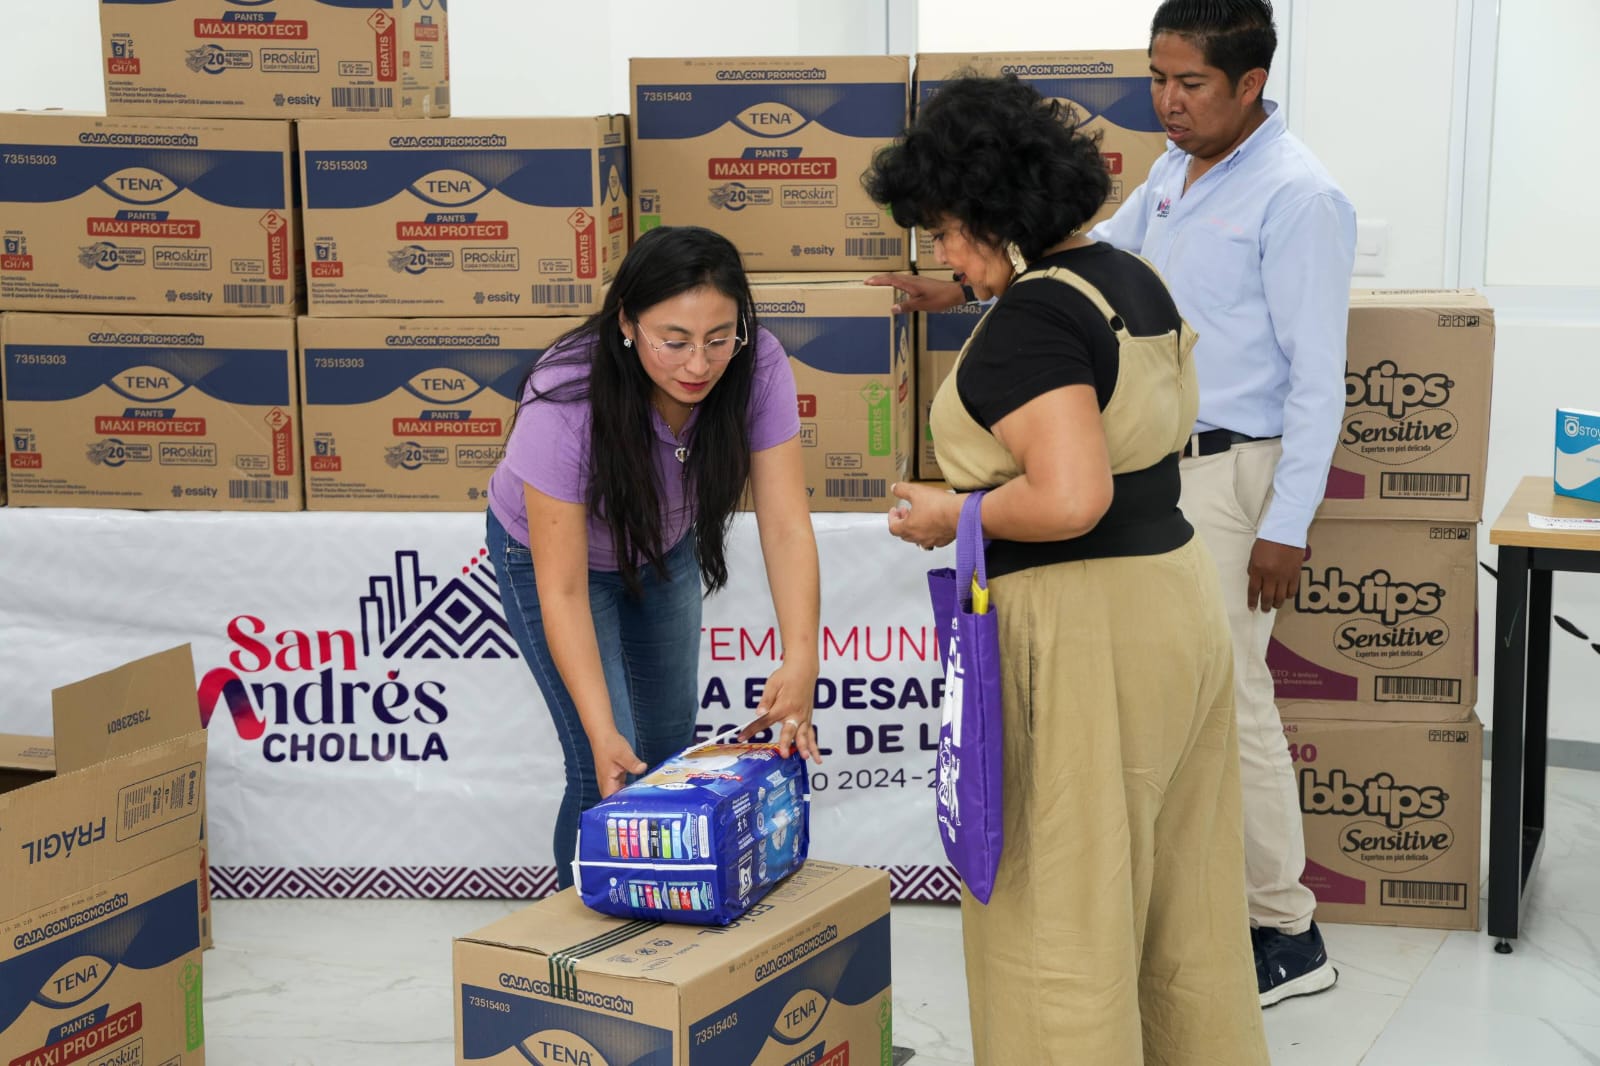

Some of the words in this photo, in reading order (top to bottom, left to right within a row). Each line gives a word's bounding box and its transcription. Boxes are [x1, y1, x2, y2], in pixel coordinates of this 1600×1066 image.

[234, 13, 265, 22] PANTS
[376, 13, 385, 25] 2
[199, 23, 235, 36] MAXI
[239, 24, 303, 37] PROTECT
[263, 52, 316, 64] PROskin
[380, 35, 390, 77] GRATIS
[111, 63, 137, 73] CH/M
[716, 70, 744, 80] CAJA
[744, 71, 766, 80] CON
[767, 69, 826, 80] PROMOCIÓN
[1002, 65, 1029, 75] CAJA
[1030, 65, 1052, 75] CON
[1053, 63, 1113, 75] PROMOCIÓN
[287, 94, 321, 107] essity
[643, 92, 692, 101] 73515403
[750, 112, 792, 124] TENA
[79, 133, 108, 144] CAJA
[109, 134, 133, 145] CON
[133, 134, 199, 146] PROMOCIÓN
[390, 136, 419, 147] CAJA
[420, 137, 444, 147] CON
[444, 134, 507, 147] PROMOCIÓN
[3, 154, 56, 165] 73515303
[755, 150, 788, 158] PANTS
[315, 160, 368, 171] 73515303
[715, 163, 754, 175] MAXI
[758, 162, 831, 175] PROTECT
[116, 178, 163, 191] TENA
[426, 180, 472, 193] TENA
[783, 188, 834, 200] PROskin
[128, 212, 157, 220] PANTS
[268, 214, 277, 226] 2
[437, 215, 466, 223] PANTS
[575, 211, 585, 224] 2
[93, 222, 128, 234] MAXI
[131, 222, 195, 235] PROTECT
[402, 225, 438, 237] MAXI
[440, 225, 503, 237] PROTECT
[156, 250, 208, 262] PROskin
[272, 236, 281, 275] GRATIS
[580, 234, 589, 275] GRATIS
[803, 245, 835, 256] essity
[4, 259, 30, 269] CH/M
[464, 252, 516, 263] PROskin
[314, 266, 341, 276] CH/M
[179, 290, 213, 303] essity
[487, 292, 520, 304] essity
[753, 301, 805, 313] OMOCIÓN
[89, 333, 118, 343] CAJA
[119, 334, 141, 344] CON
[142, 333, 204, 345] PROMOCIÓN
[386, 335, 414, 346] CAJA
[415, 336, 437, 346] CON
[438, 334, 499, 346] PROMOCIÓN
[15, 354, 66, 365] 73515303
[314, 358, 364, 368] 73515303
[124, 376, 169, 388] TENA
[421, 378, 465, 391] TENA
[1344, 359, 1455, 419] btips
[135, 410, 163, 418] PANTS
[272, 411, 281, 423] 2
[431, 411, 460, 419] PANTS
[101, 420, 135, 432] MAXI
[138, 421, 201, 433] PROTECT
[398, 422, 433, 433] MAXI
[435, 422, 497, 433] PROTECT
[1342, 420, 1452, 445] Sensitive
[162, 445, 214, 458] PROskin
[277, 433, 285, 471] GRATIS
[185, 486, 217, 498] essity
[1295, 567, 1445, 625] bbtips
[227, 615, 357, 672] San
[1337, 627, 1444, 650] Sensitive
[197, 667, 448, 740] Andrés
[846, 724, 904, 755] DE
[262, 732, 448, 762] CHOLULA
[838, 768, 937, 791] 2024-2
[1300, 768, 1450, 829] bbtips
[22, 816, 106, 864] FRÁGIL
[1342, 829, 1449, 853] Sensitive
[14, 930, 44, 950] CAJA
[45, 919, 69, 937] CON
[70, 893, 128, 929] PROMOCIÓN
[755, 963, 776, 982] CAJA
[776, 952, 795, 968] CON
[795, 925, 837, 960] PROMOCIÓN
[53, 964, 99, 994] TENA
[499, 973, 532, 992] CAJA
[469, 996, 510, 1013] 73515403
[784, 997, 817, 1029] TENA
[60, 1013, 95, 1037] PANTS
[695, 1012, 738, 1046] 73515403
[63, 1011, 137, 1060] PROTECT
[538, 1041, 593, 1066] TENA
